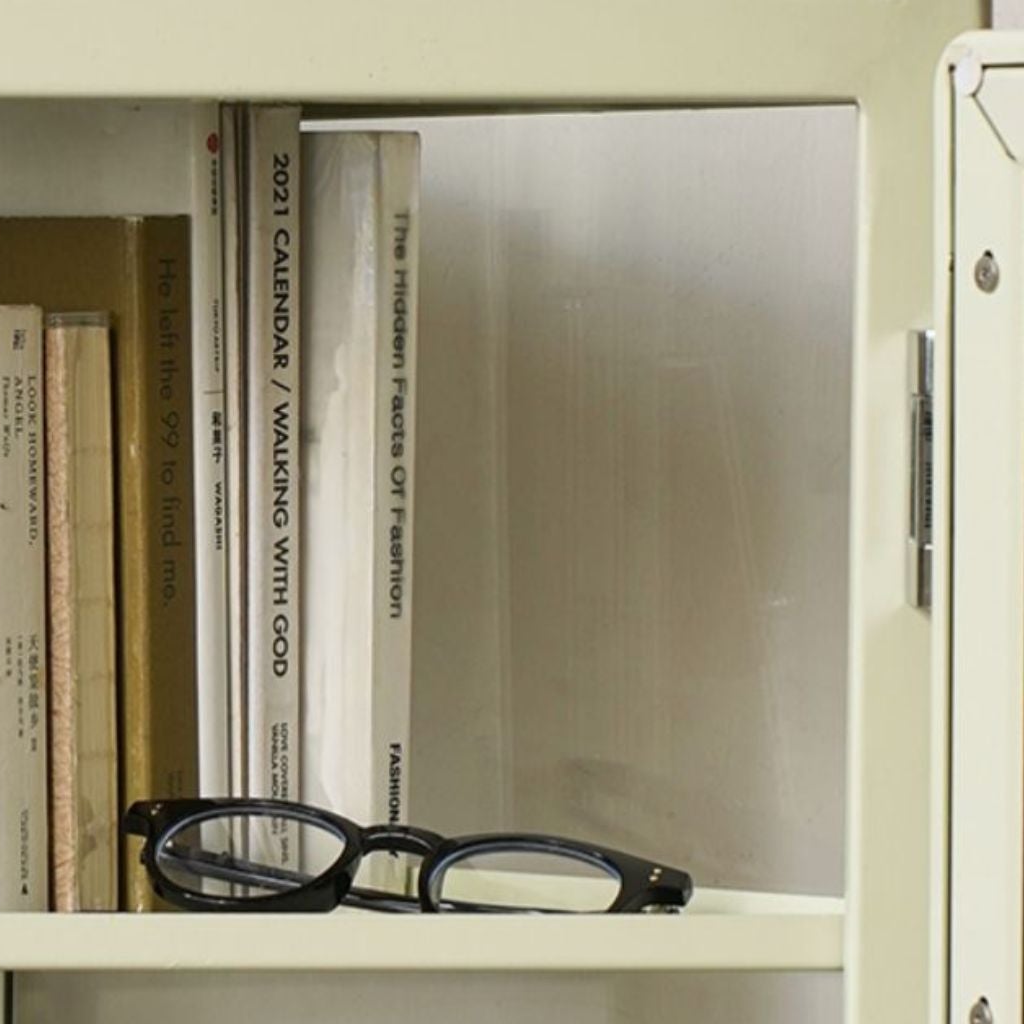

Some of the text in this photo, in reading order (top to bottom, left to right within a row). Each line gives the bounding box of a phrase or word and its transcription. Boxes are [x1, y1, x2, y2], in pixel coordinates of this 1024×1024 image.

[273, 153, 289, 217] 2021
[158, 257, 177, 297] He
[273, 228, 290, 369] CALENDAR
[159, 309, 180, 348] left
[27, 375, 37, 426] LOOK
[159, 359, 180, 401] the
[160, 410, 180, 449] 99
[389, 208, 410, 620] The Hidden Facts Of Fashion
[160, 459, 178, 485] to
[272, 401, 289, 528] WALKING
[160, 496, 182, 549] find
[272, 536, 289, 605] WITH
[272, 614, 289, 678] GOD
